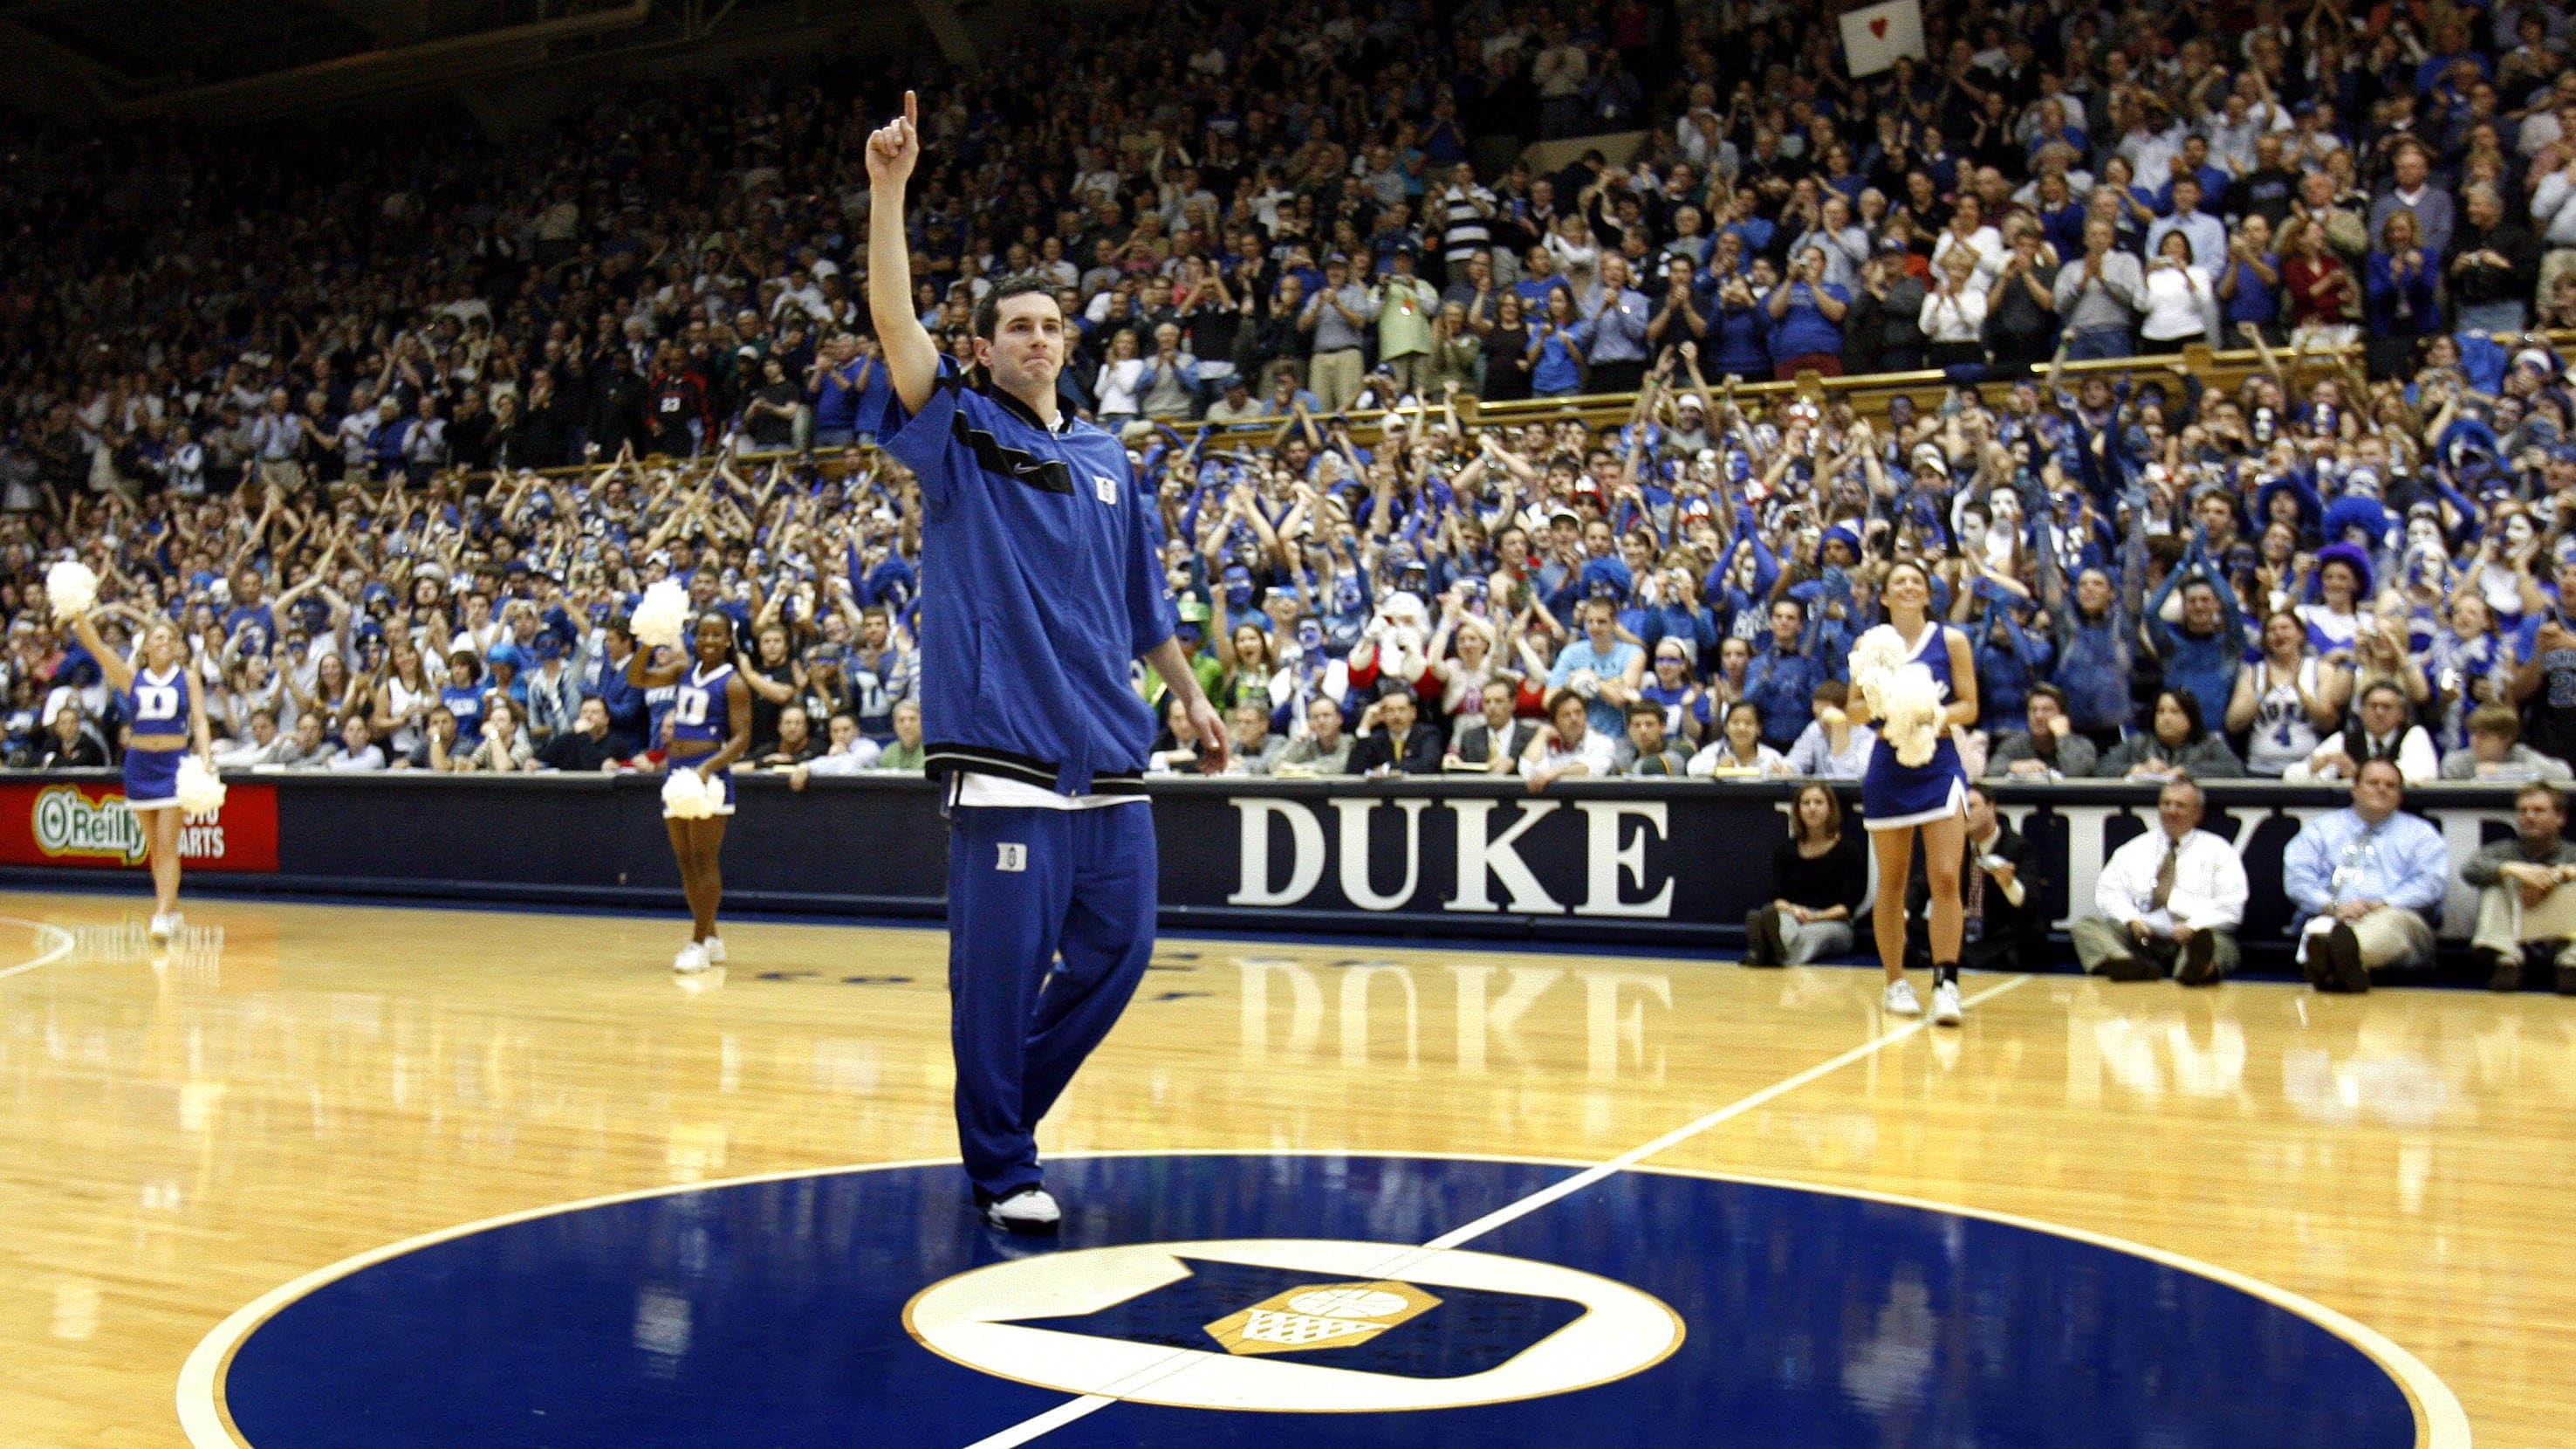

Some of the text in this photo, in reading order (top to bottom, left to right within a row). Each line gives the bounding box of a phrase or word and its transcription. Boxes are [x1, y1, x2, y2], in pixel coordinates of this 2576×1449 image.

[134, 685, 180, 721] D
[675, 684, 710, 726] D
[176, 826, 225, 858] ARTS
[995, 841, 1027, 872] D
[1226, 797, 1677, 918] DUKE
